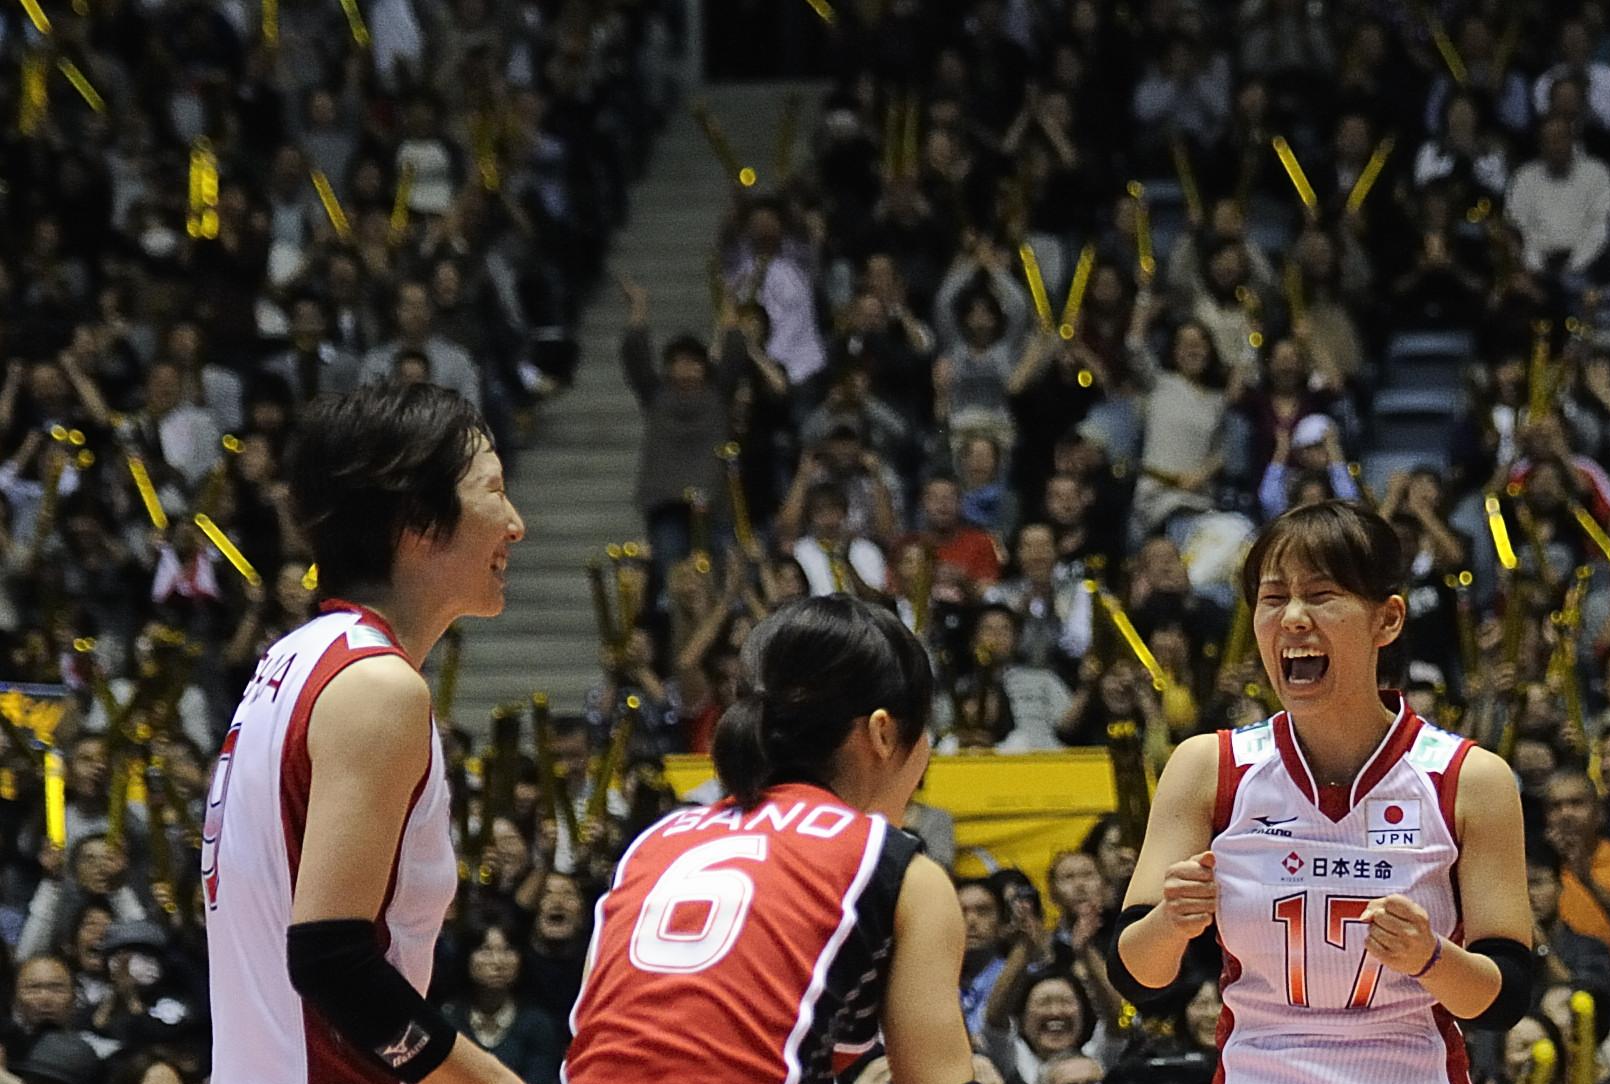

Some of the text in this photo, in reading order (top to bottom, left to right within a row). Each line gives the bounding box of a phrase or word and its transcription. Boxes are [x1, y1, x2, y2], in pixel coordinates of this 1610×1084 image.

[662, 802, 854, 838] SANO
[1375, 833, 1414, 846] JPN
[1312, 858, 1393, 879] 日本生命
[629, 835, 768, 974] 6
[1272, 890, 1387, 1010] 17
